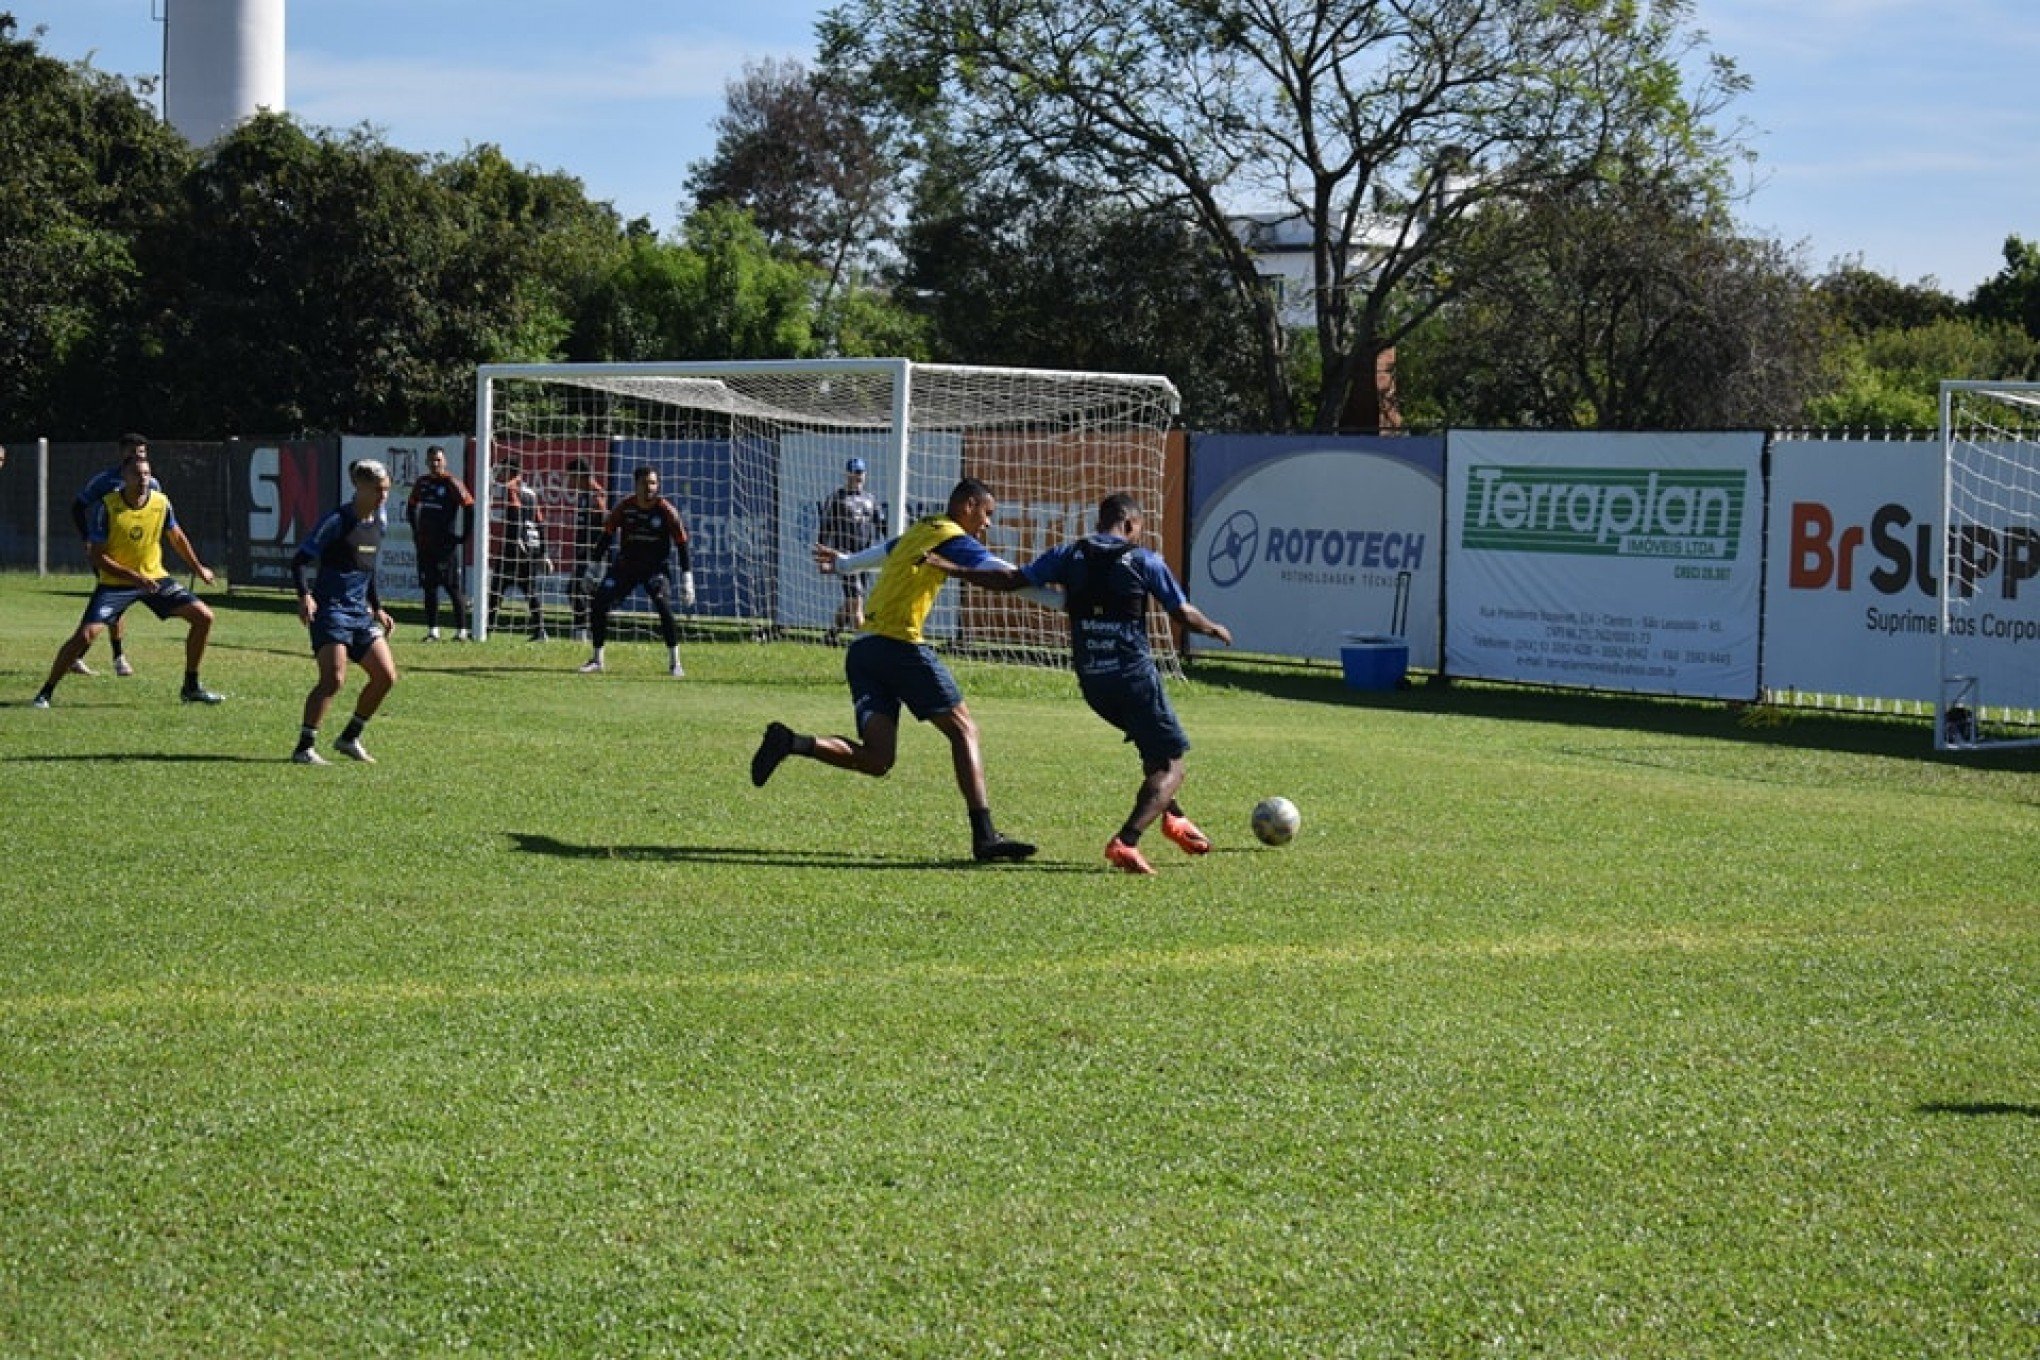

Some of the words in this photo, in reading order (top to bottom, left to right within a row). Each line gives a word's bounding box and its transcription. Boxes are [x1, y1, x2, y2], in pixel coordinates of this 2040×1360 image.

[249, 446, 319, 544] SN
[1476, 469, 1729, 543] Terraplan
[1265, 526, 1425, 569] ROTOTECH
[1628, 537, 1682, 553] IMÓVEIS
[1685, 540, 1716, 555] LTDA
[1866, 607, 1975, 637] Suprimetos
